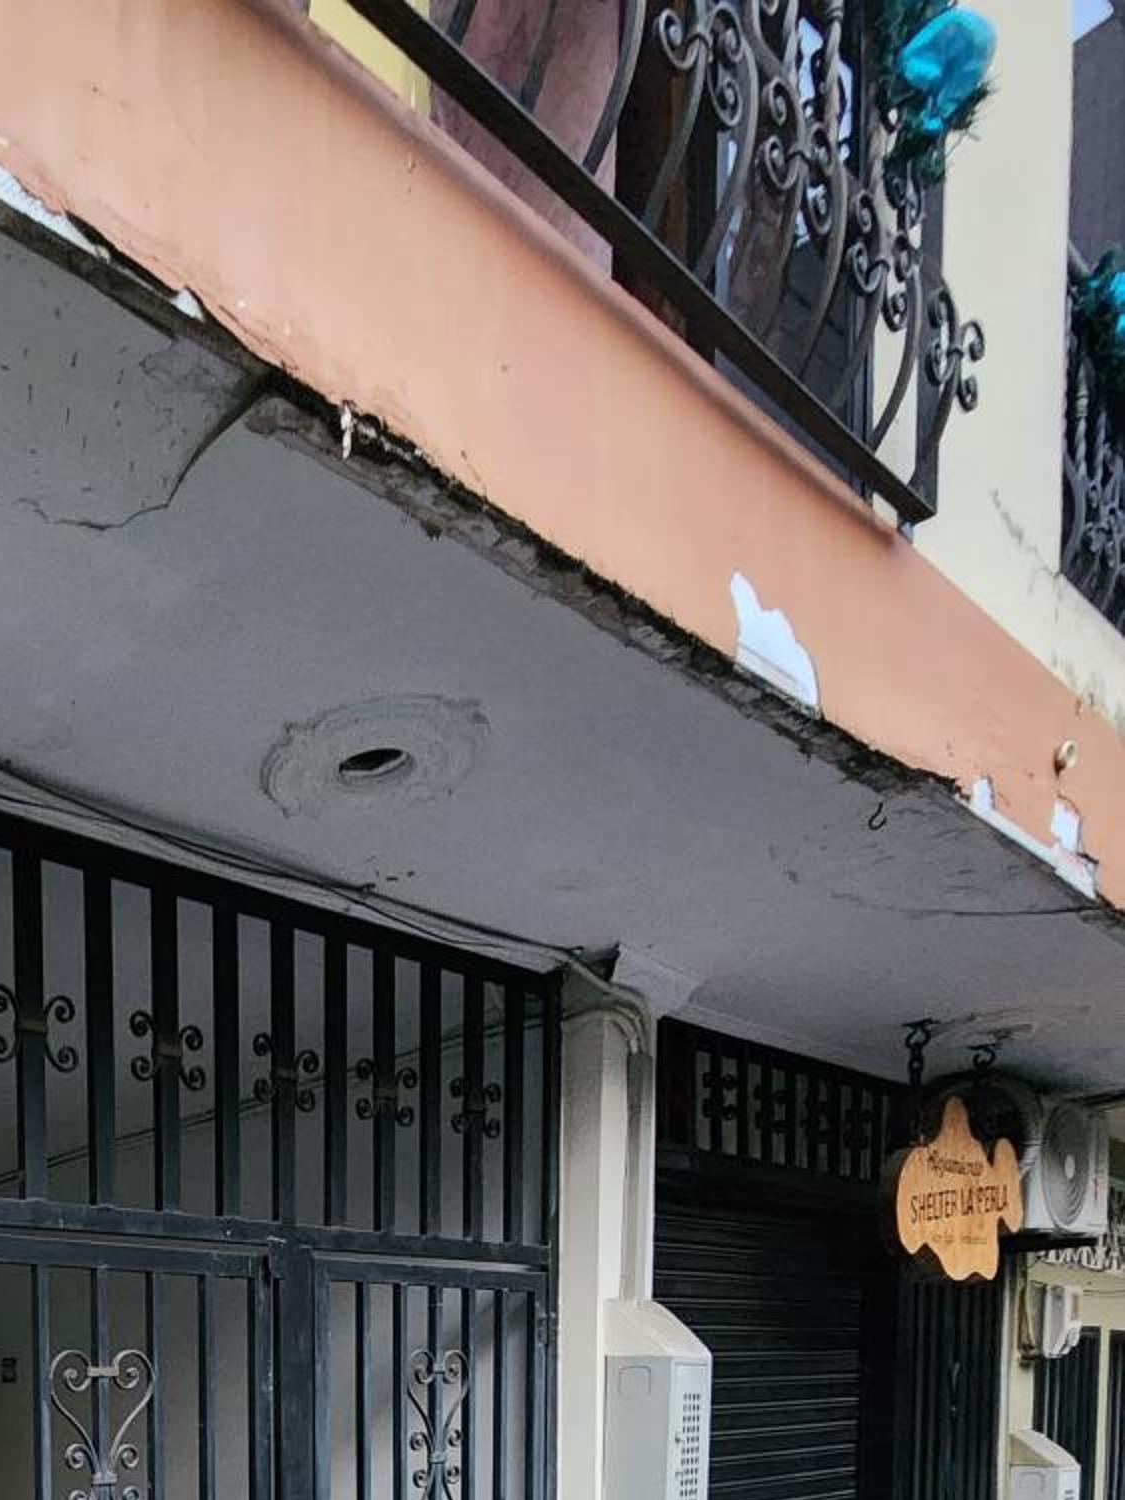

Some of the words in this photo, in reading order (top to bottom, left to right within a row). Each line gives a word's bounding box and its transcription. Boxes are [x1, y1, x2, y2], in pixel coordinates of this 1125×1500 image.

[911, 1190, 956, 1224] SHELTER
[960, 1187, 974, 1216] LA
[976, 1184, 1008, 1215] PERLA
